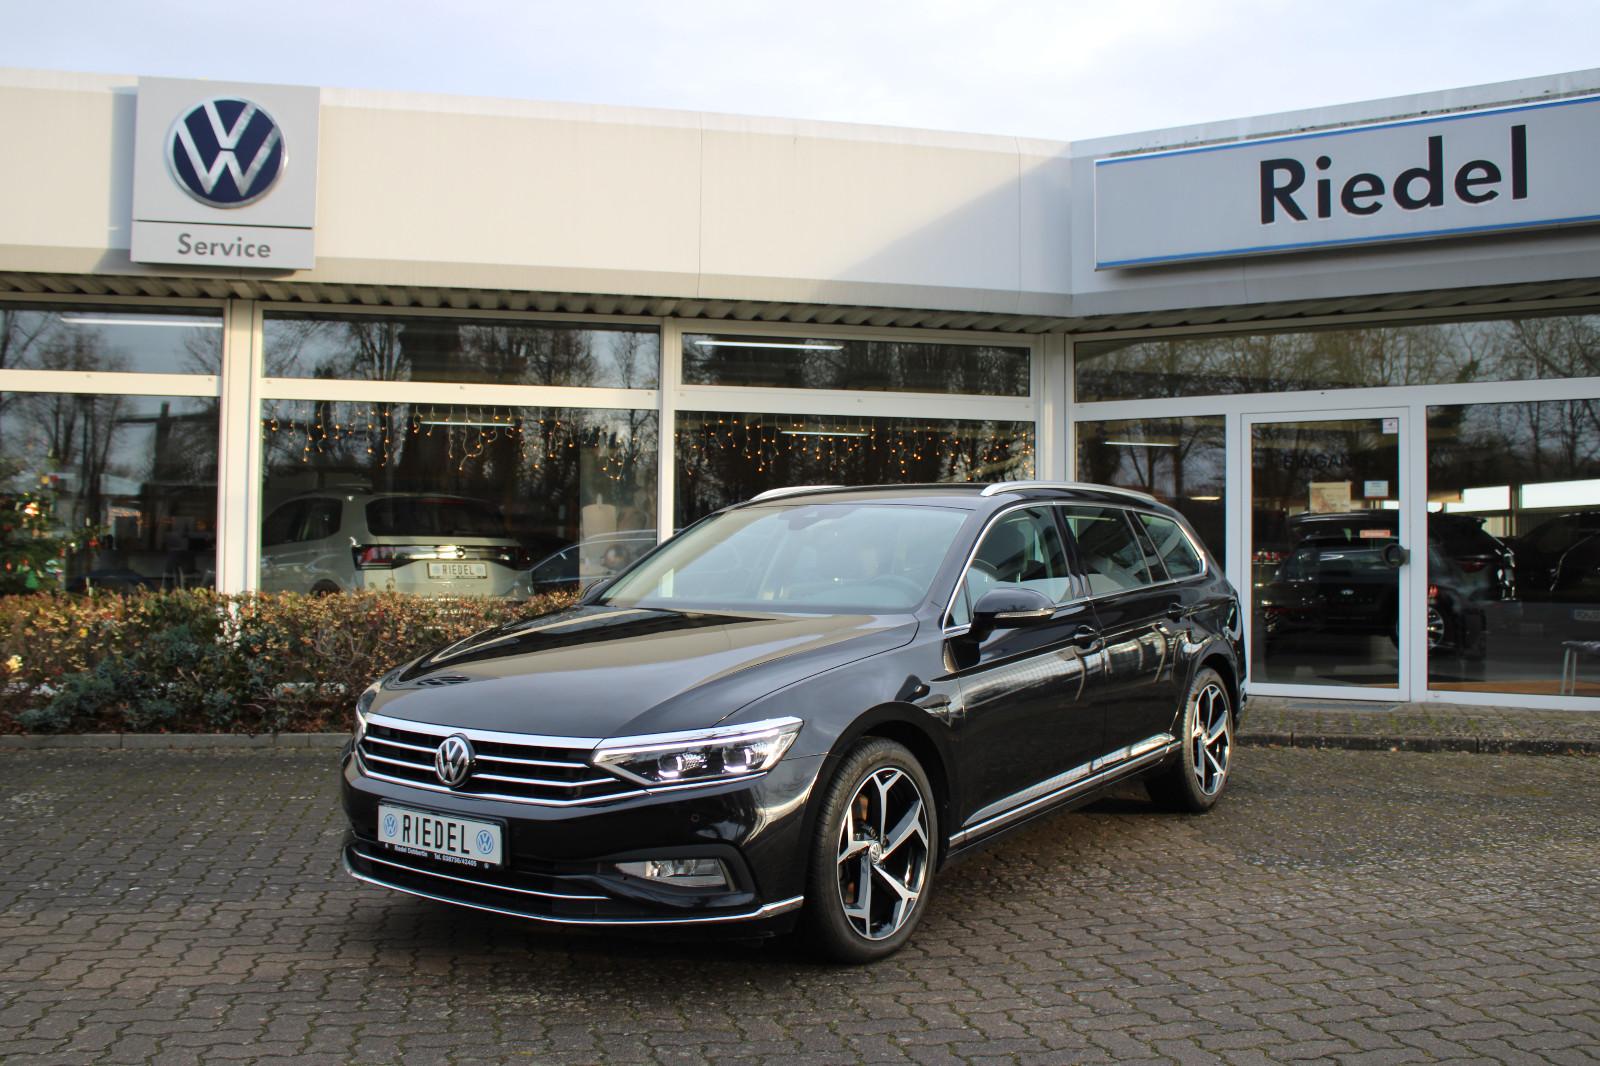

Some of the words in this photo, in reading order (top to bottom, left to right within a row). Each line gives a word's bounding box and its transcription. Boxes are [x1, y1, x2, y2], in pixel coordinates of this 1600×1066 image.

[1260, 124, 1528, 225] Riedel
[178, 233, 271, 257] Service
[442, 564, 474, 575] RIEDEL
[402, 814, 469, 854] RIEDEL
